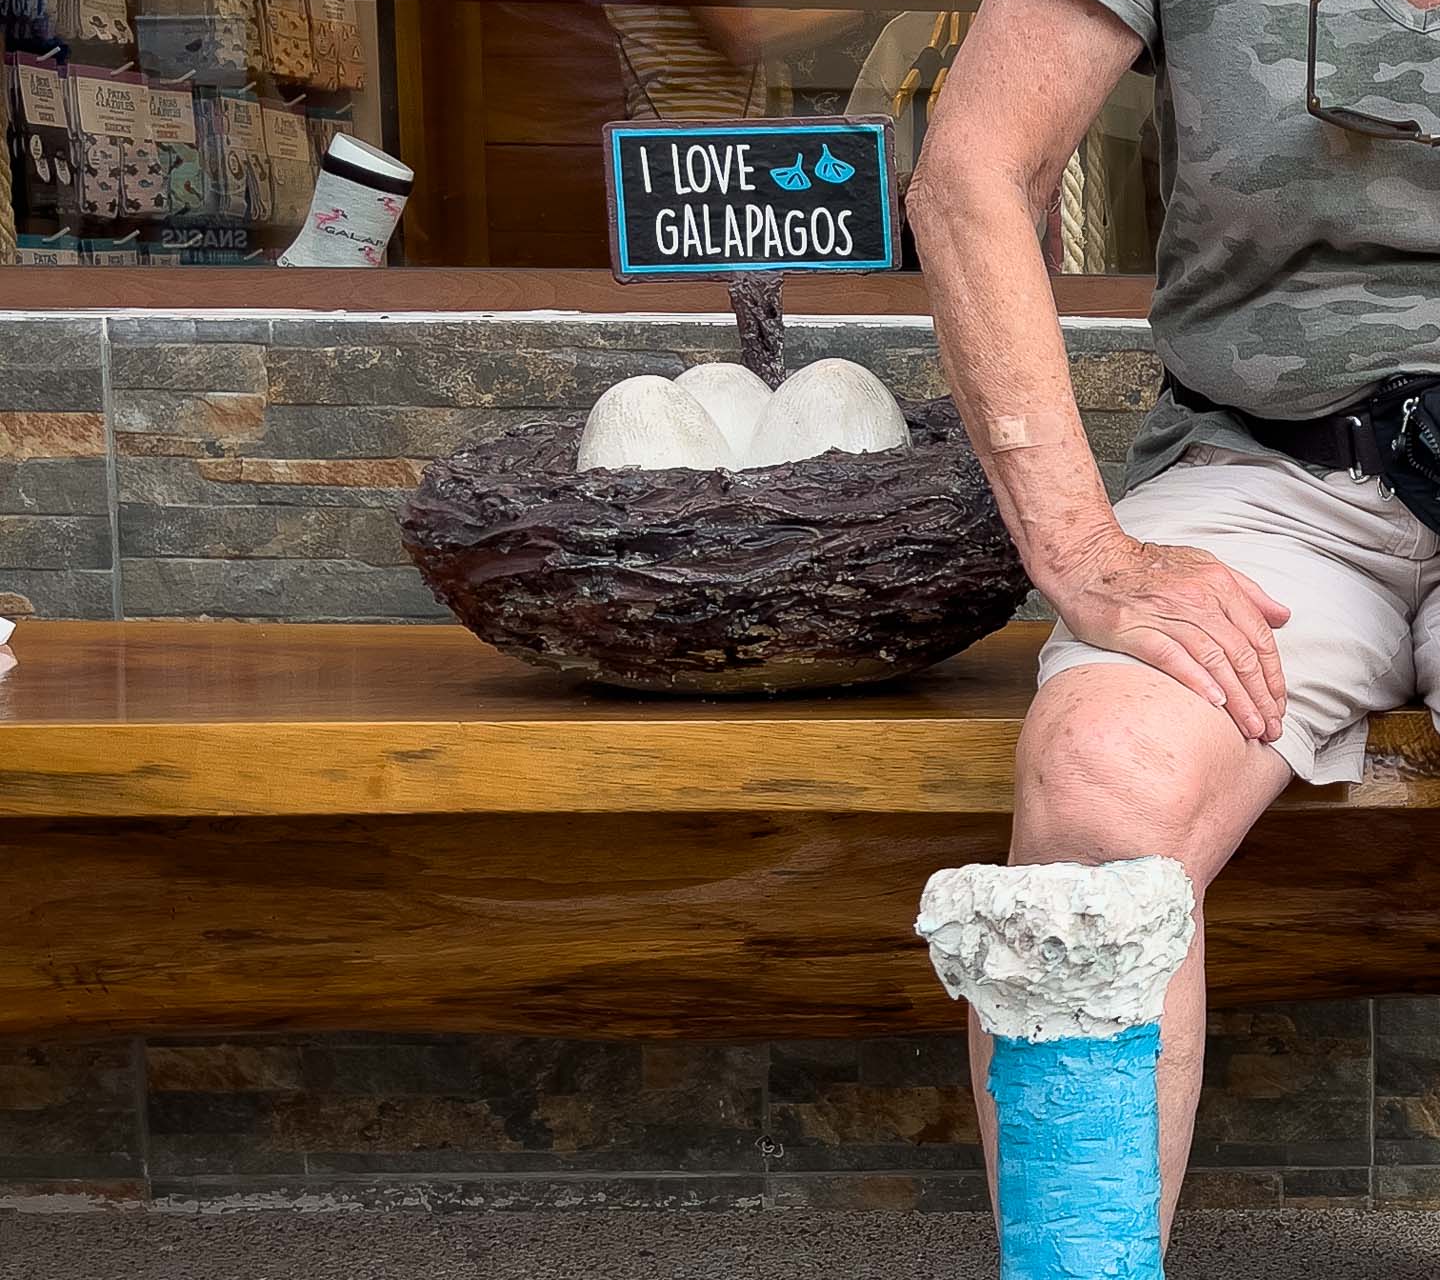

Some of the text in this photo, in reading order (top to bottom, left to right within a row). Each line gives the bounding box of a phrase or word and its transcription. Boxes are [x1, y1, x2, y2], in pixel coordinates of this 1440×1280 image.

[639, 143, 756, 195] I LOVE
[655, 203, 854, 258] GALAPAGOS
